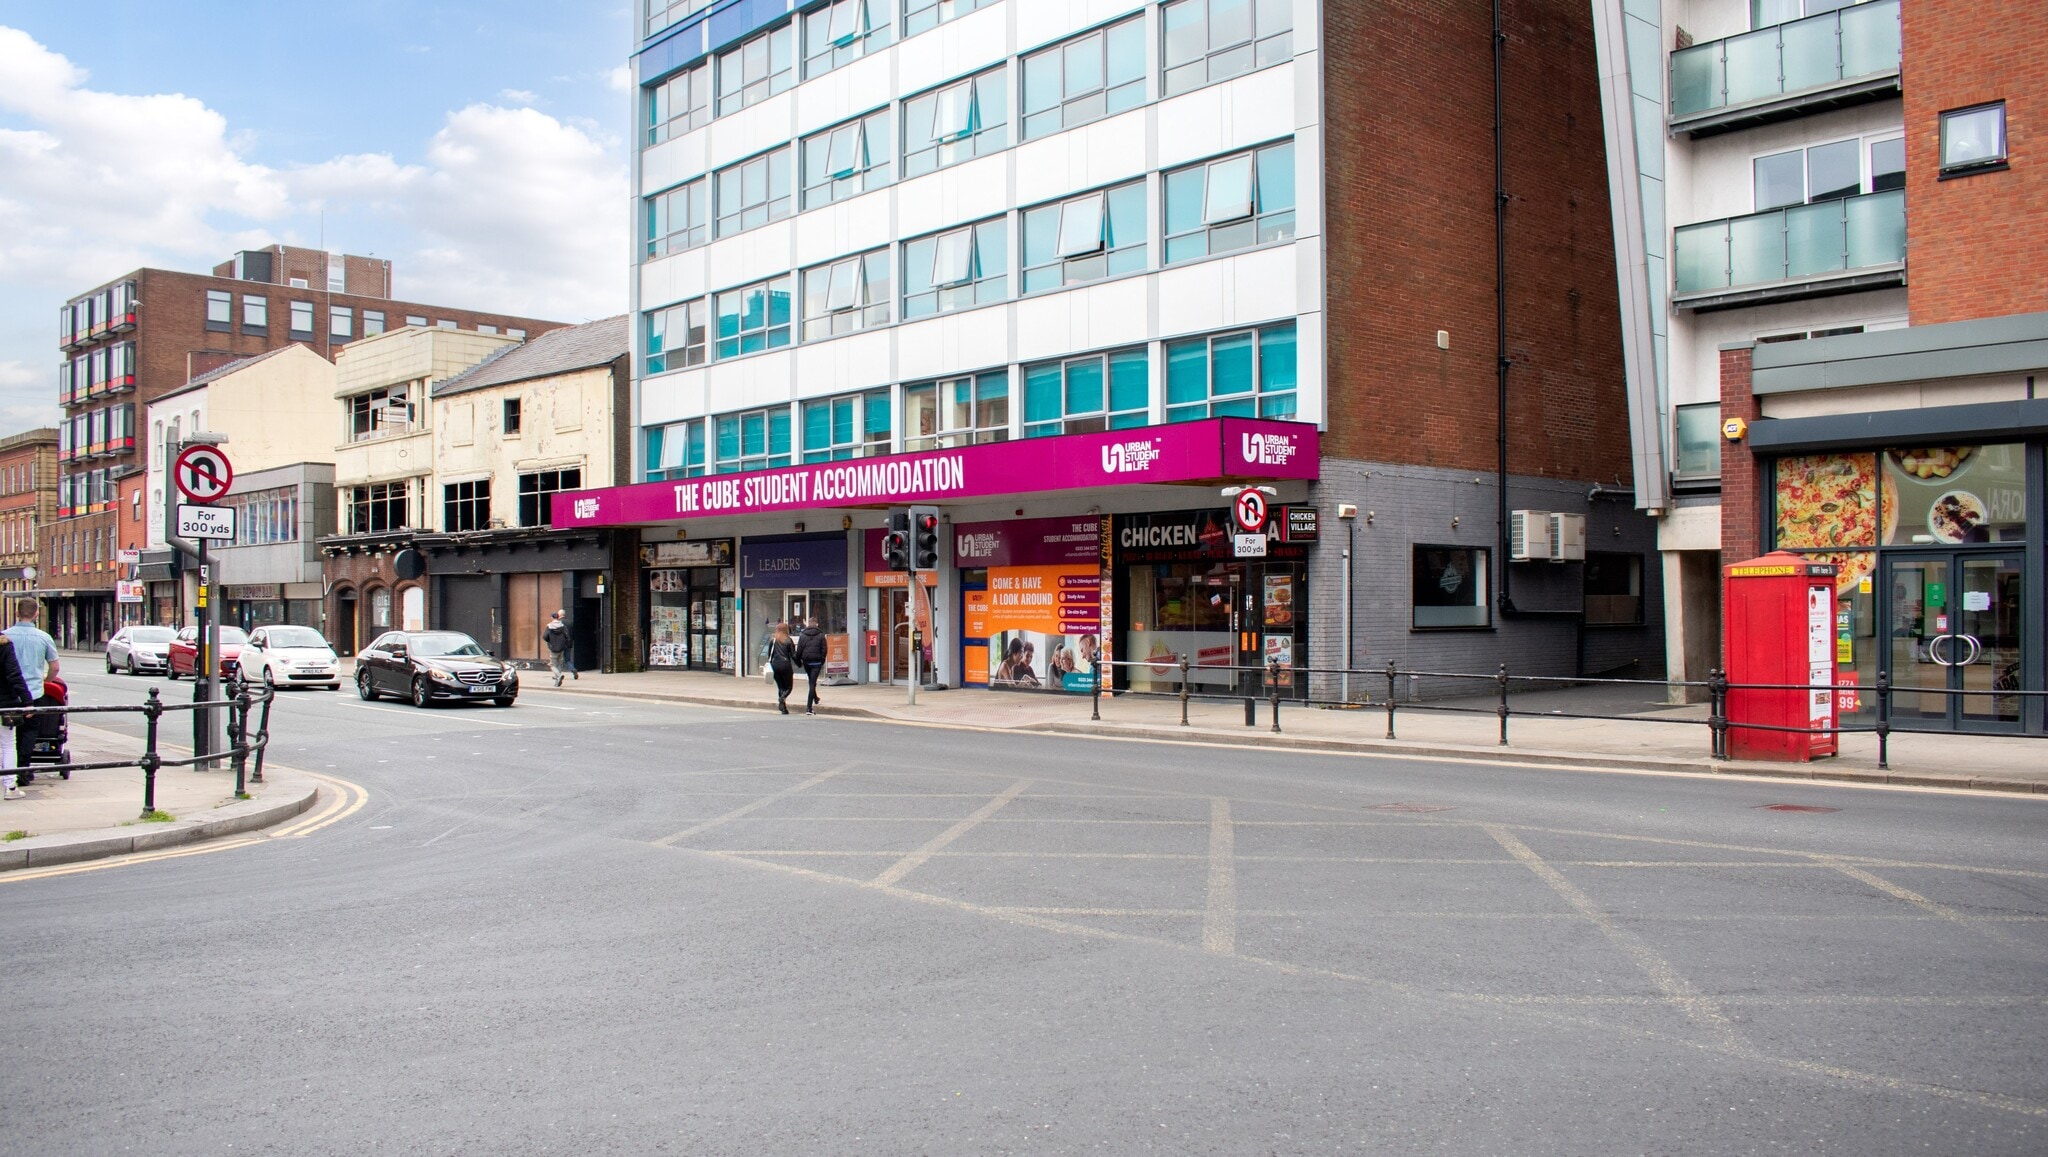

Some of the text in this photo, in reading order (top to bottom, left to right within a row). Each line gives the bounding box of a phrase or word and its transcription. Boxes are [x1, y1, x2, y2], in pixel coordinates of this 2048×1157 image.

[1265, 434, 1289, 446] URBAN
[1125, 440, 1152, 453] URBAN
[1265, 444, 1297, 456] STUDENT
[1125, 449, 1160, 462] STUDENT
[1272, 454, 1287, 465] LIFE
[1132, 460, 1150, 471] LIFE
[674, 455, 964, 512] THE CUBE STUDENT ACCOMMODATION
[197, 510, 216, 521] For
[1289, 512, 1316, 521] CHICKEN
[182, 522, 230, 535] 300 yds
[1072, 522, 1098, 533] THE CUBE
[1290, 522, 1317, 531] VILLAGE
[974, 533, 994, 541] URBAN
[1043, 533, 1098, 543] STUDENT ACCOMMODATION
[1121, 524, 1196, 547] CHICKEN
[1245, 537, 1256, 545] For
[975, 540, 999, 549] STUDENT
[1252, 546, 1264, 554] yds
[980, 548, 992, 557] LIFE
[743, 555, 801, 578] L LEADERS
[1737, 566, 1790, 575] TELEPHONE
[875, 575, 897, 584] WELCOME
[897, 575, 904, 584] TO
[992, 576, 1042, 589] COME & HAVE
[992, 593, 998, 605] A
[999, 593, 1019, 605] LOOK
[1020, 592, 1053, 605] AROUND
[968, 604, 988, 612] THE CUBE
